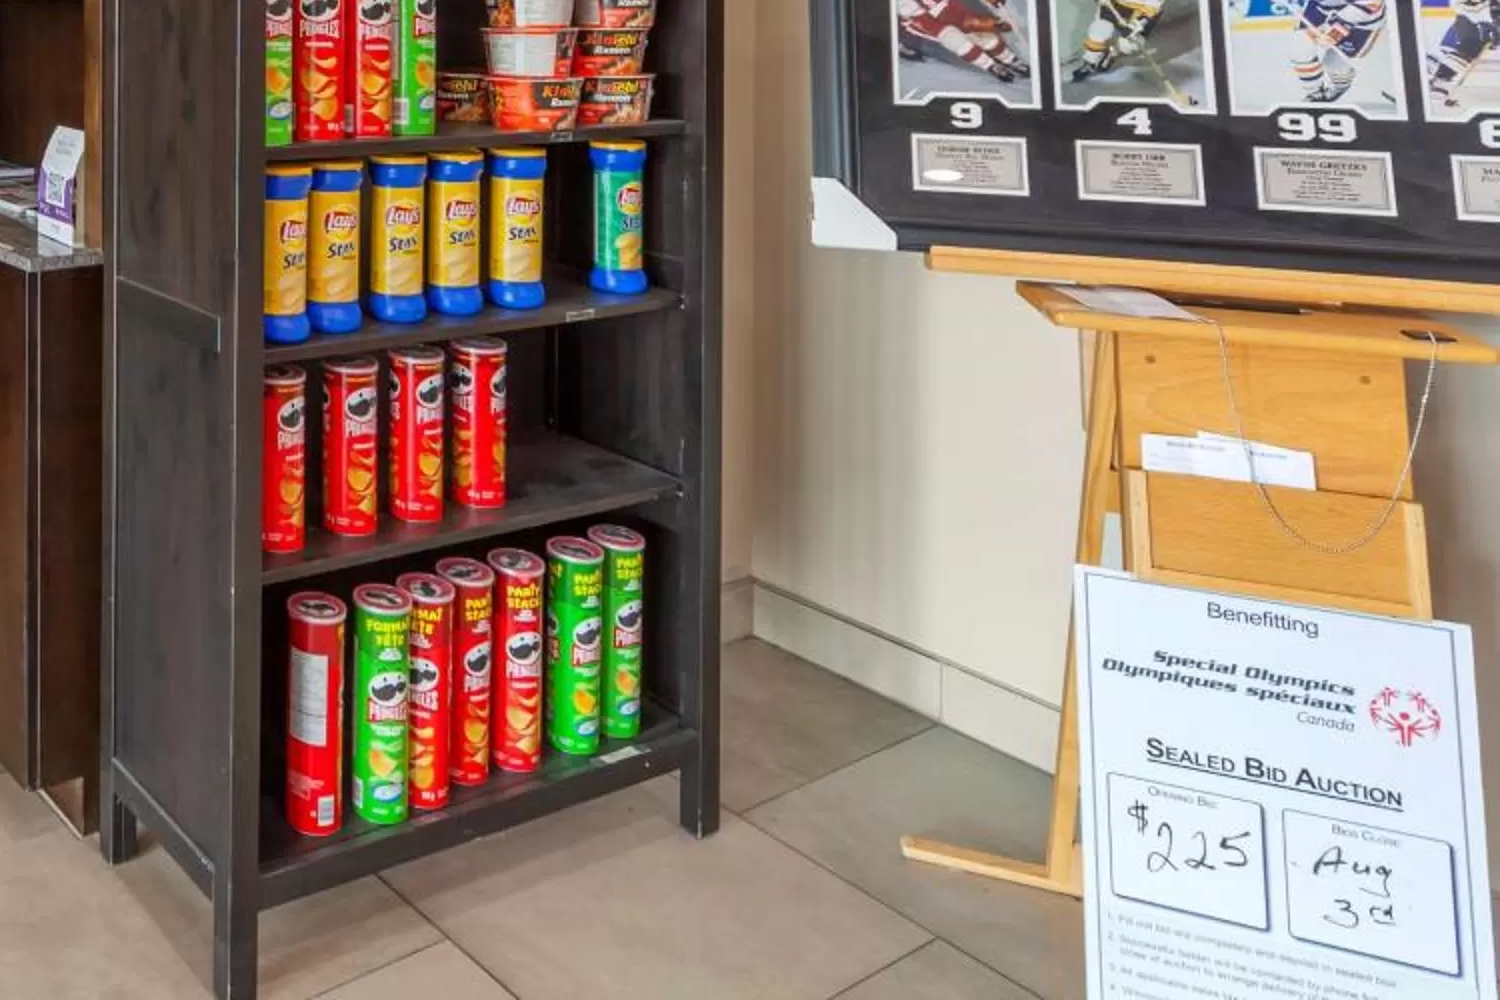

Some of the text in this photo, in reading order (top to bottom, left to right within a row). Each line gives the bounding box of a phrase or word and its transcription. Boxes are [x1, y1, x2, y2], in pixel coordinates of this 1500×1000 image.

[950, 102, 984, 130] 9
[1116, 107, 1153, 136] 4
[1276, 112, 1358, 143] 99
[1207, 601, 1320, 639] Benefitting
[1101, 657, 1357, 714] Olympiques spéciaux
[1153, 650, 1356, 697] Special Olympics
[1296, 711, 1356, 733] Canada
[1295, 767, 1402, 807] AUCTION
[1312, 845, 1393, 899] Aug
